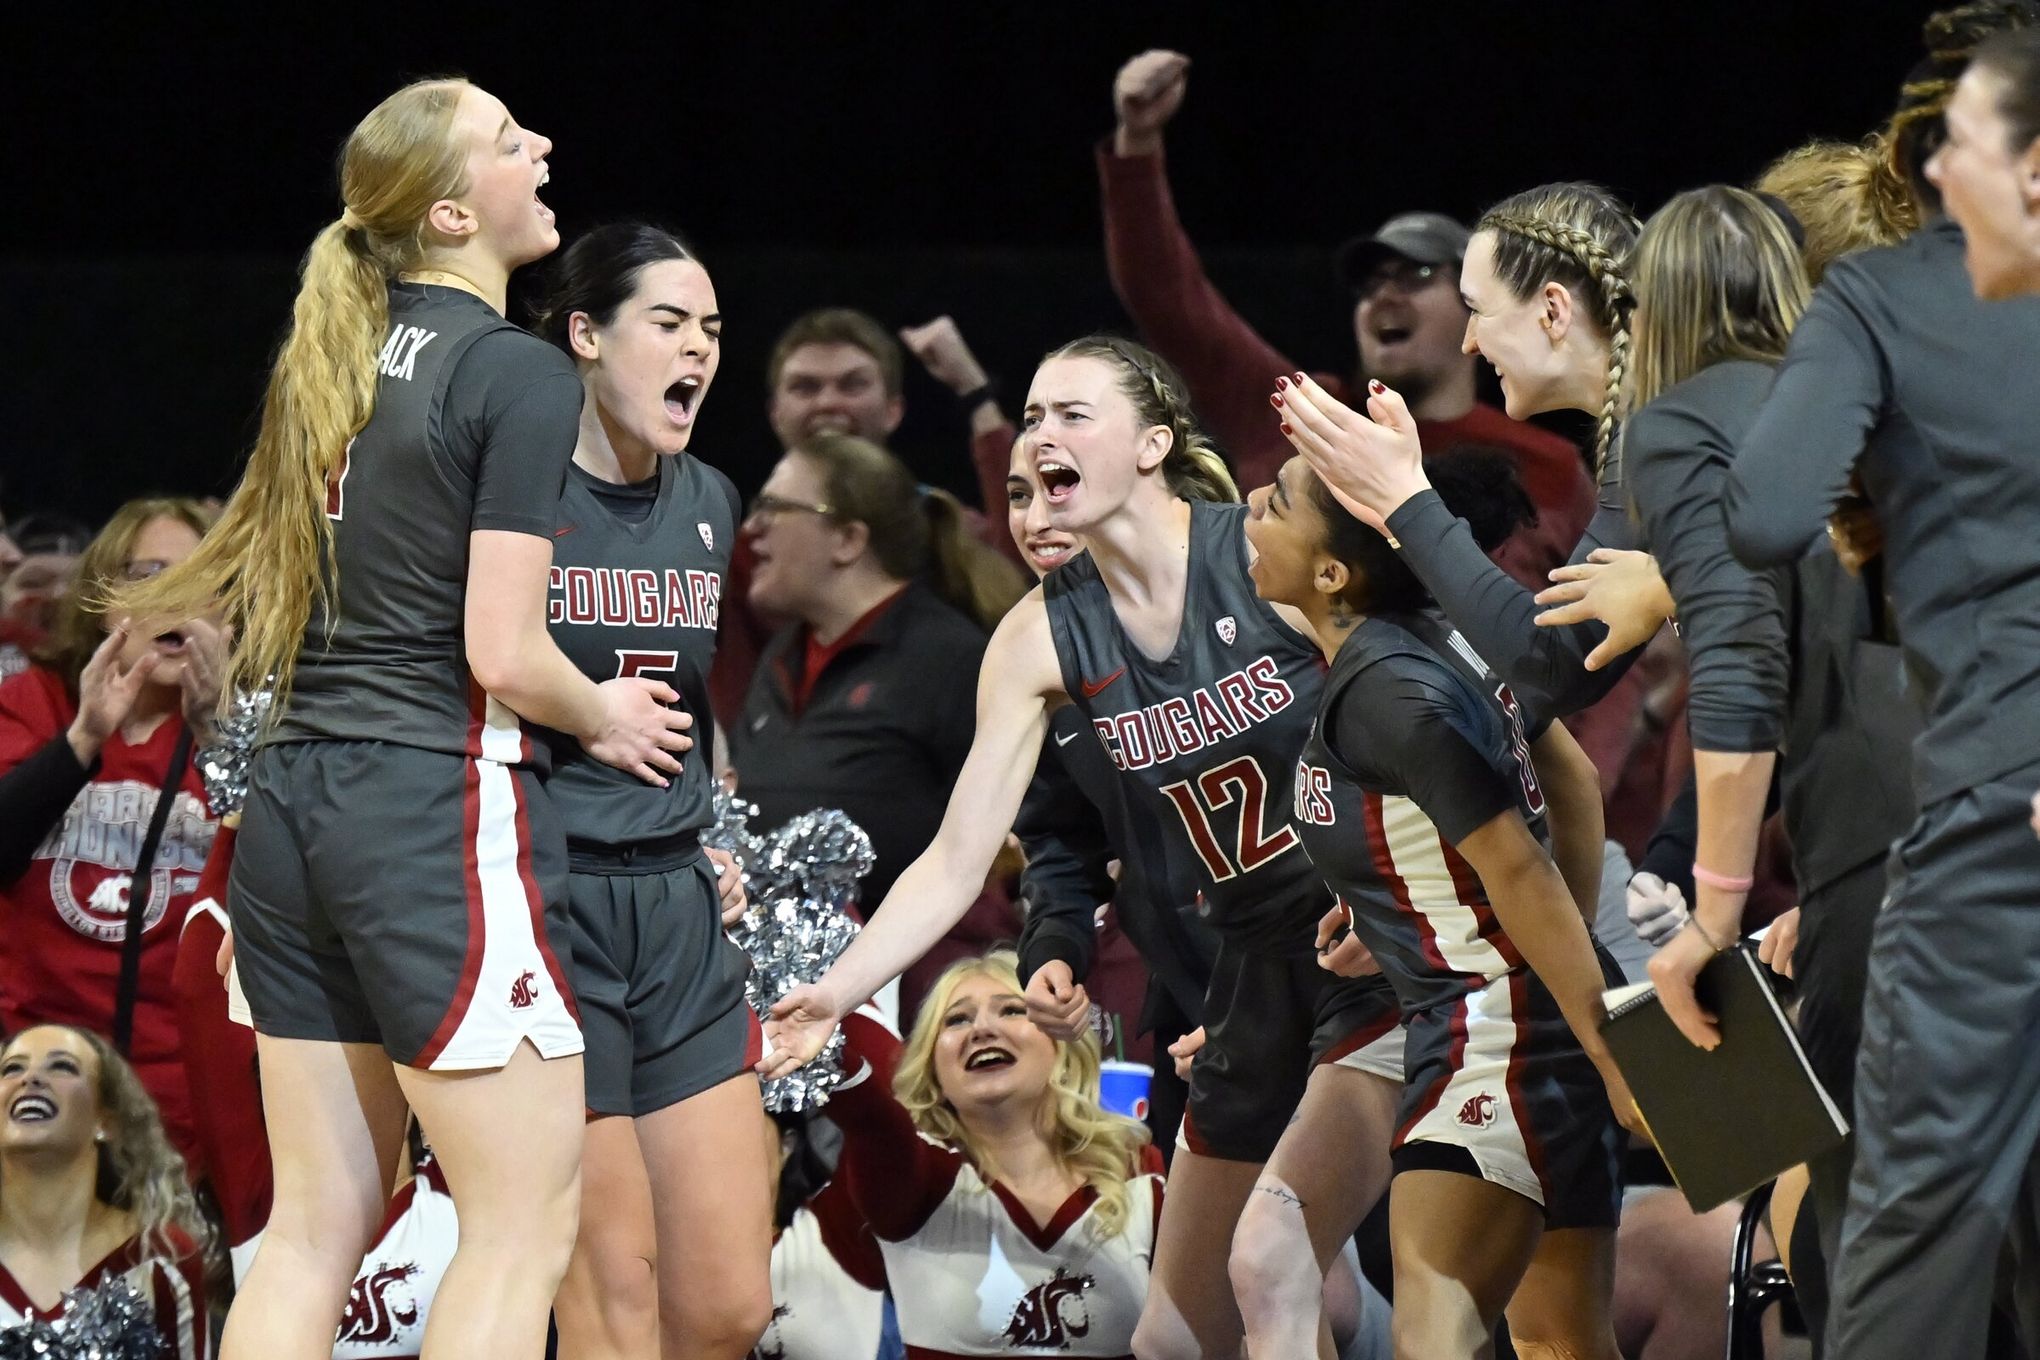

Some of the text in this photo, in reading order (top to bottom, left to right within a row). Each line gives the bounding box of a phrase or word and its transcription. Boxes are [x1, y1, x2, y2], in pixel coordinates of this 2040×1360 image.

[550, 565, 721, 630] COUGARS
[1093, 655, 1295, 771] COUGARS
[1158, 755, 1300, 883] 12
[1294, 755, 1336, 826] RS
